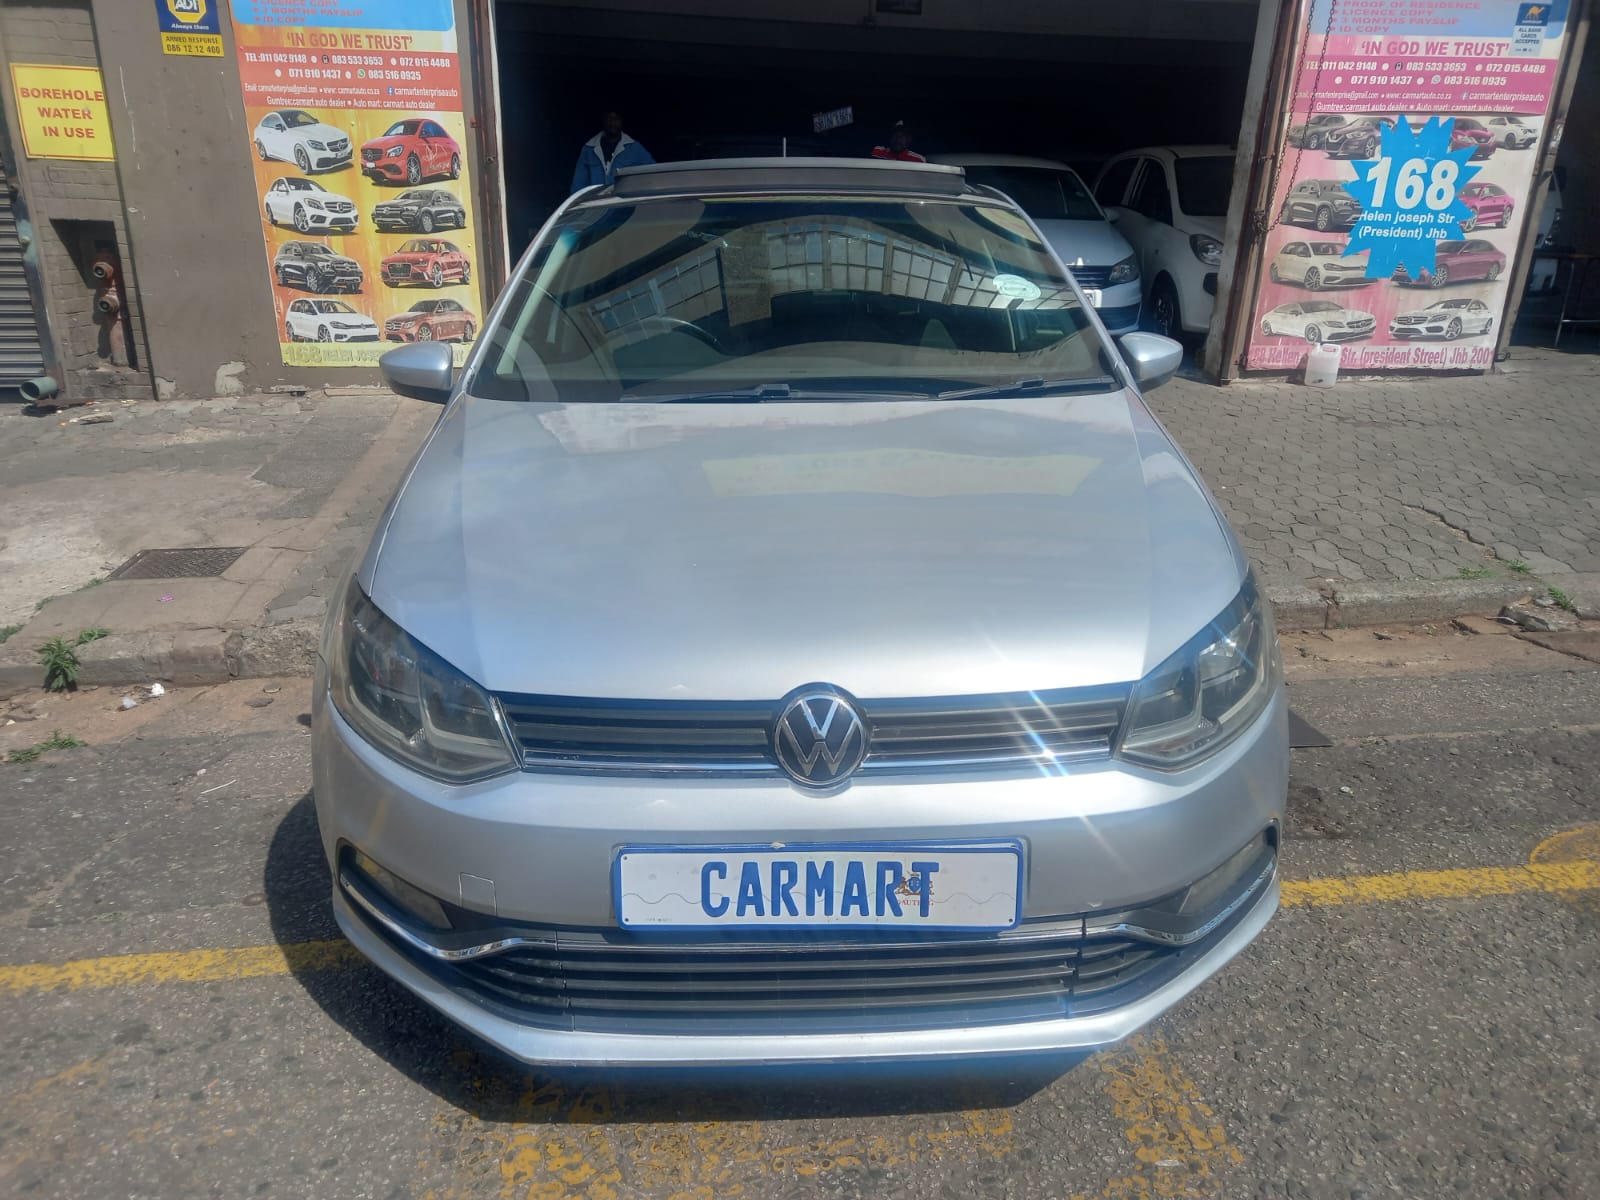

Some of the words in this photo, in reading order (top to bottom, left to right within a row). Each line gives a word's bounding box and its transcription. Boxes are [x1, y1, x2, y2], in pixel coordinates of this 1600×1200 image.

[1409, 1, 1481, 9] RESIDENCE
[271, 7, 317, 15] MONTHS
[320, 8, 362, 16] PAYSLIP
[166, 35, 187, 43] ARMED
[189, 36, 218, 44] RESPONSE
[310, 33, 338, 47] GOD
[341, 33, 362, 48] WE
[365, 34, 413, 50] TRUST'
[195, 45, 204, 53] 12
[1387, 41, 1420, 56] GOD
[1425, 42, 1449, 56] WE
[1454, 42, 1510, 57] TRUST'
[1356, 62, 1377, 71] 9148
[1406, 62, 1424, 71] 083
[1425, 62, 1442, 71] 533
[1486, 63, 1502, 72] 072
[1504, 64, 1521, 73] 015
[322, 69, 341, 79] 1437
[1350, 75, 1369, 85] 071
[1369, 76, 1388, 85] 910
[1390, 76, 1412, 85] 1437
[1444, 76, 1463, 85] 083
[1464, 76, 1481, 85] 516
[1482, 77, 1507, 86] 0935
[20, 87, 104, 102] BOREHOLE
[1371, 103, 1386, 112] auto
[1387, 102, 1408, 112] dealer
[1416, 103, 1431, 112] Auto
[1451, 104, 1477, 112] carmart
[1478, 104, 1493, 112] auto
[1493, 104, 1514, 112] dealer
[37, 107, 93, 120] WATER
[42, 126, 59, 137] IN
[63, 127, 95, 138] USE
[1366, 156, 1459, 211] 168
[1359, 210, 1391, 222] Helen
[1359, 226, 1423, 240] (President)
[1426, 228, 1447, 239] Jhb
[1359, 347, 1411, 366] (president
[1414, 347, 1447, 365] Street)
[1449, 347, 1468, 364] Jhb
[700, 861, 940, 917] CARMART
